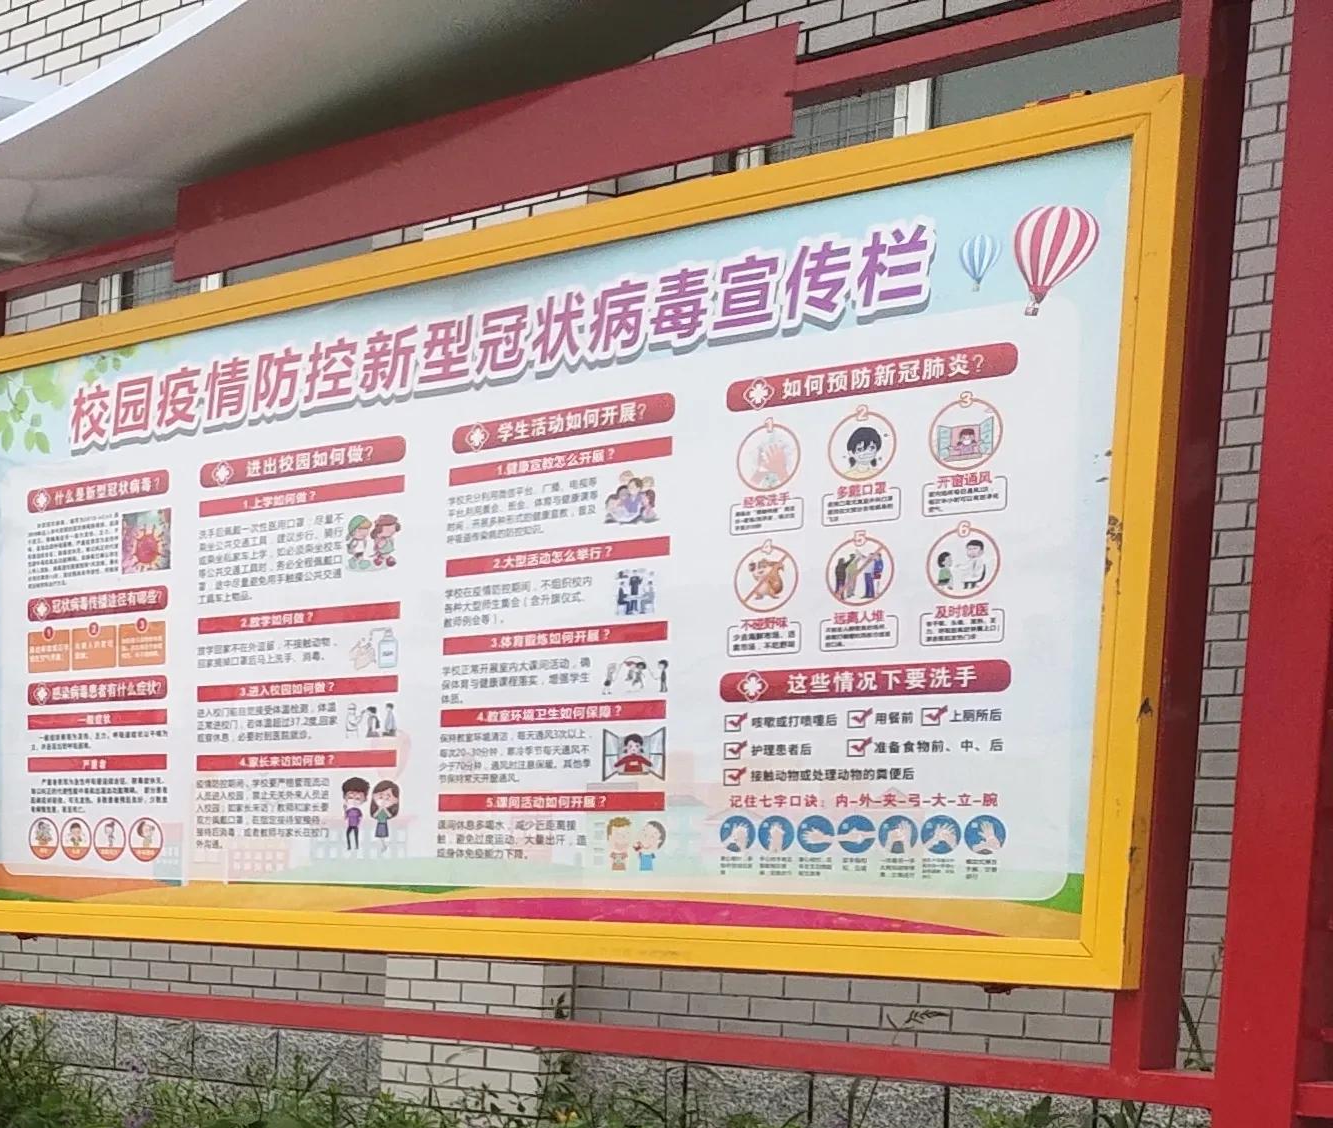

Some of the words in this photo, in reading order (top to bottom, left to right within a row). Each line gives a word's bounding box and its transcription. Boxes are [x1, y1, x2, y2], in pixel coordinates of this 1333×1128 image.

[71, 224, 933, 443] 校园疫情防控新型冠状病毒宣传栏
[937, 471, 993, 489] 开窗通风
[934, 602, 990, 619] 及时就医
[786, 666, 978, 695] 这些情况下要洗手
[874, 711, 914, 725] 用餐前
[949, 708, 1003, 723] 上厕所后
[750, 742, 812, 757] 护理患者后
[873, 739, 1004, 754] 准备食物前、中、后
